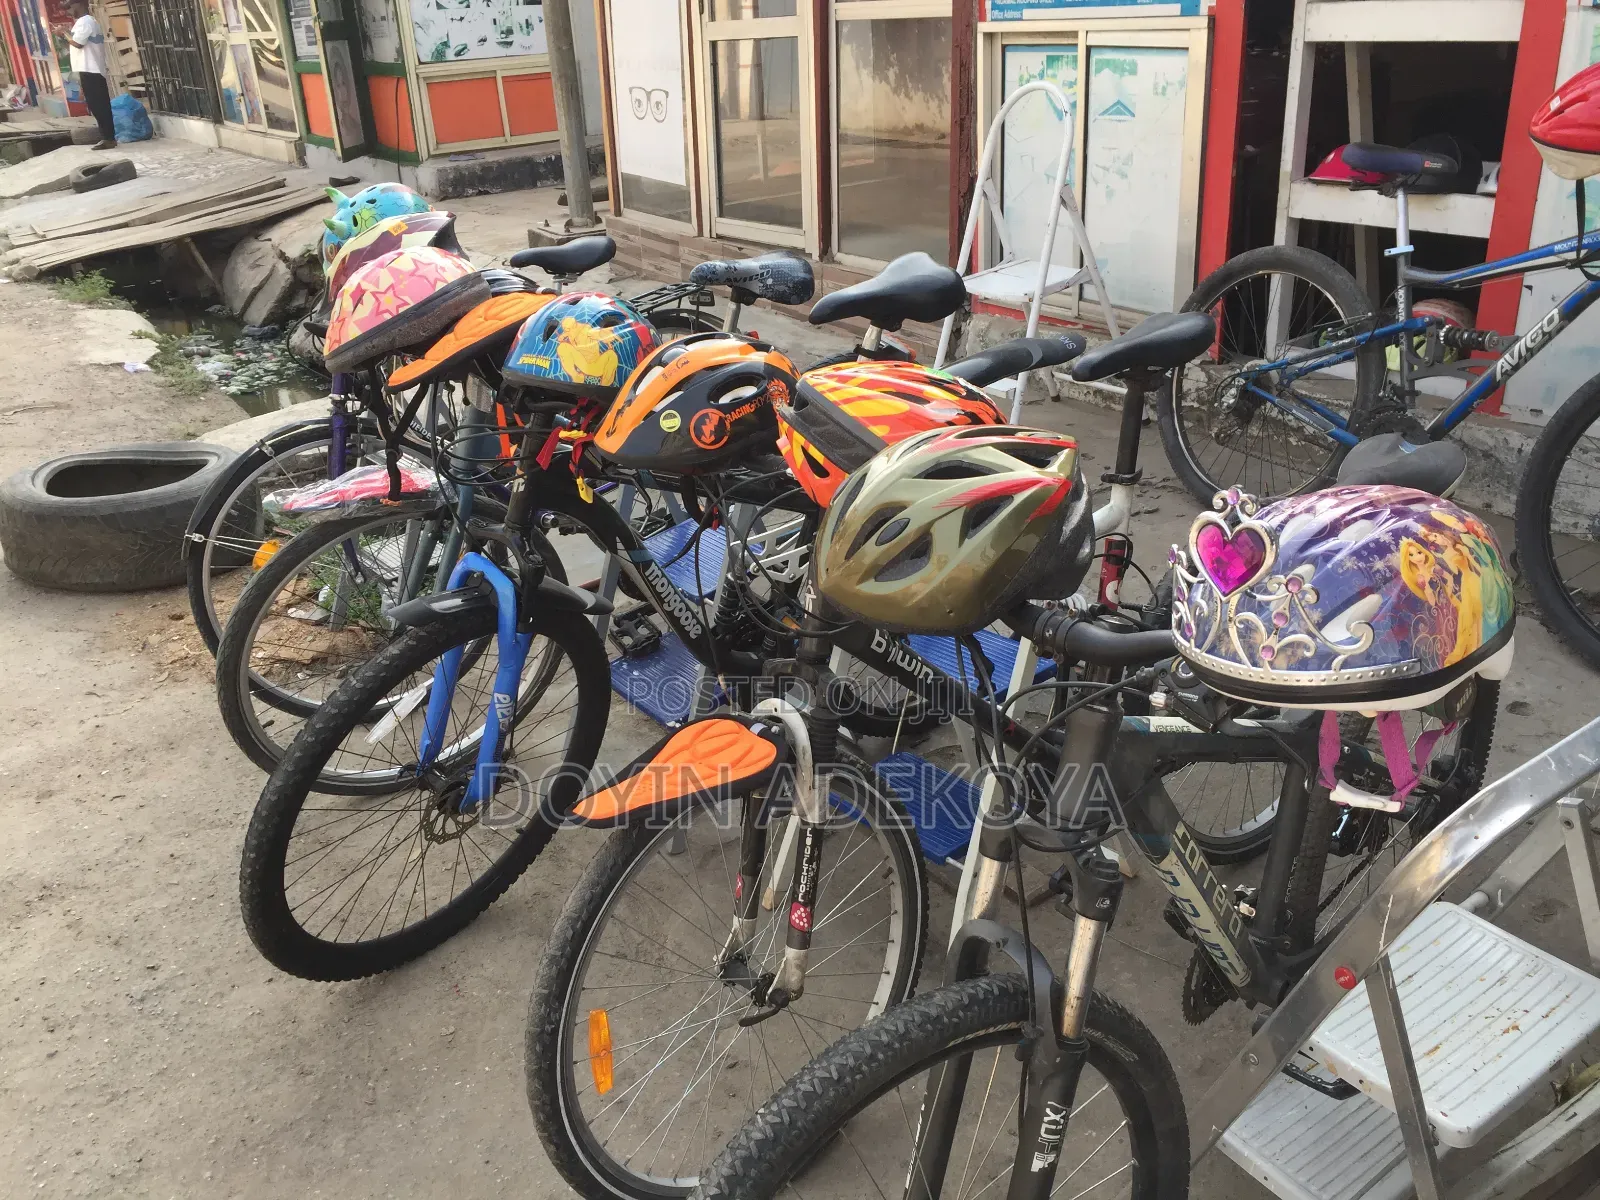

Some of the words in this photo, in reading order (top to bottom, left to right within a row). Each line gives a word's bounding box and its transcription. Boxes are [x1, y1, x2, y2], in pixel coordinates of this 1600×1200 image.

[1397, 286, 1405, 322] MOUNTA
[1496, 308, 1561, 382] AVIGO
[725, 402, 755, 423] RACING
[645, 562, 702, 639] mongoose
[1153, 724, 1193, 733] VENGEANCE
[1172, 820, 1242, 939] carrera
